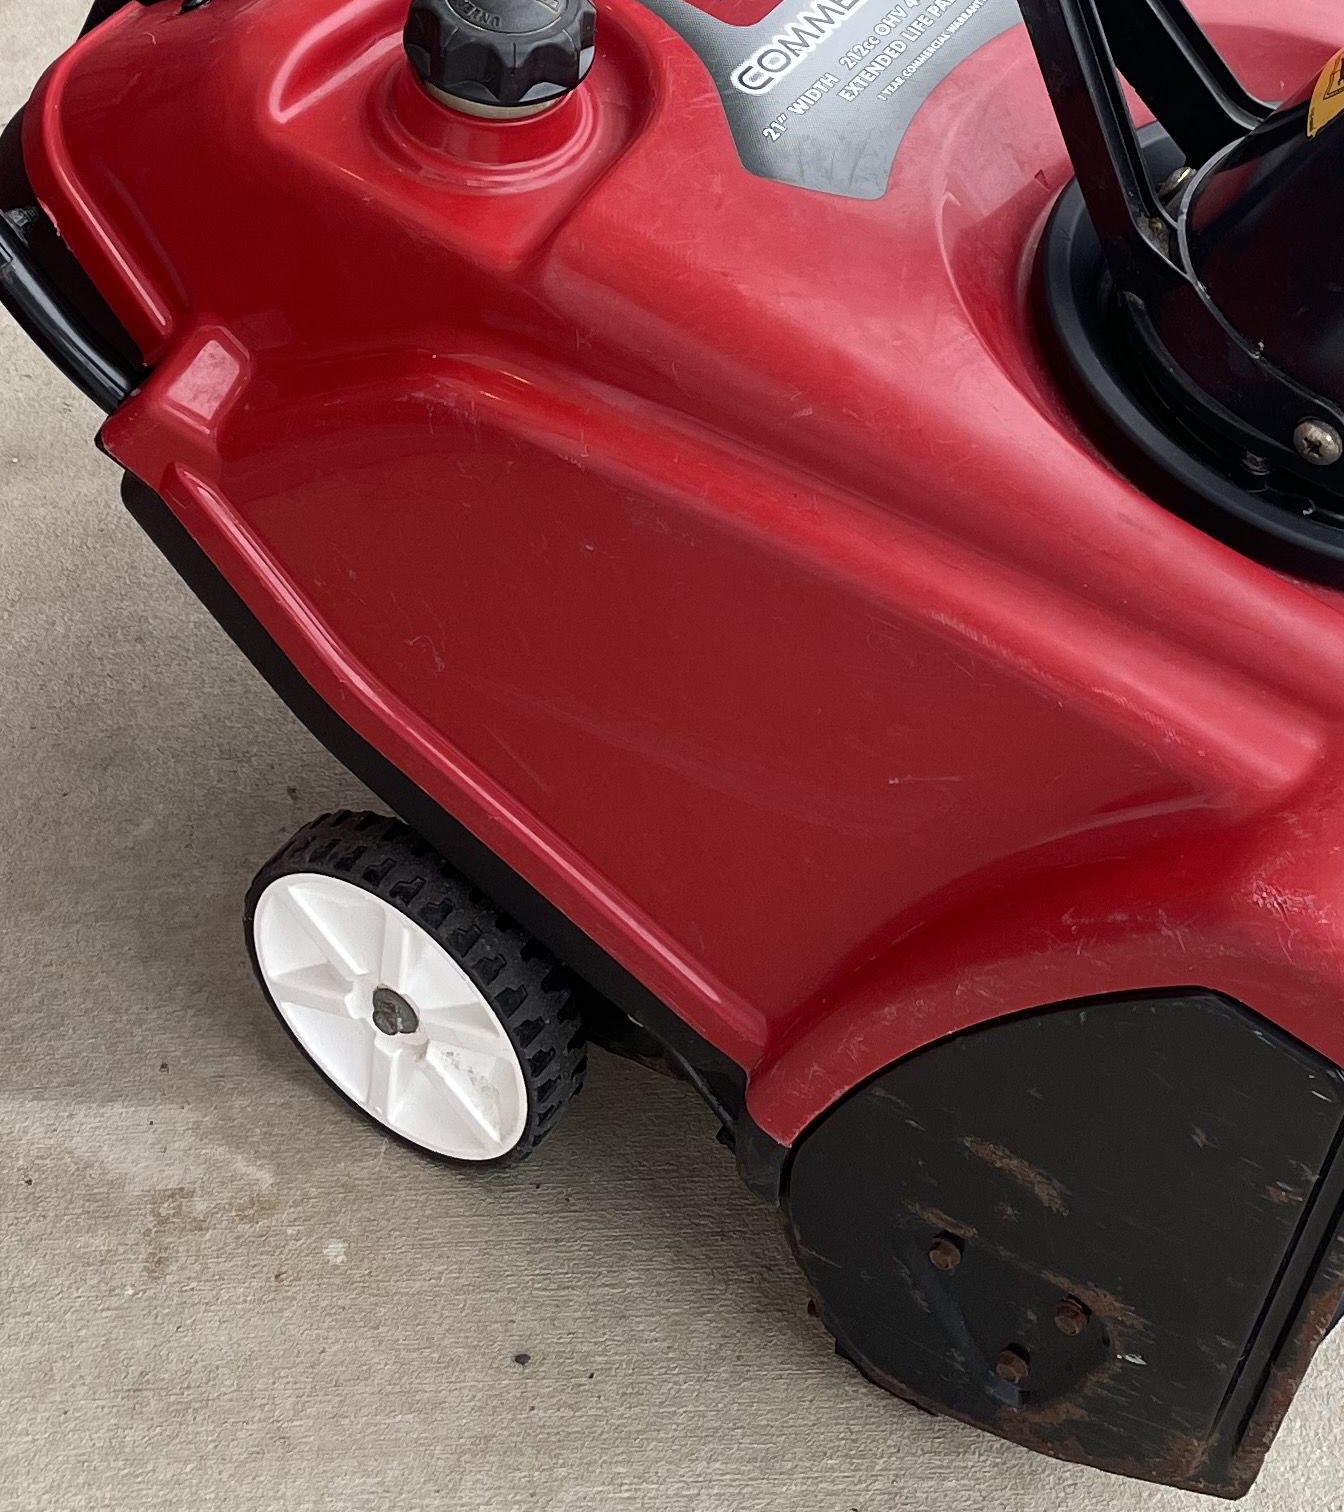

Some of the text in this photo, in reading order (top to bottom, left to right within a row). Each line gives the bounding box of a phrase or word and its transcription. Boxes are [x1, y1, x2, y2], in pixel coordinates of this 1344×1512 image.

[762, 113, 788, 143] 21"
[787, 71, 841, 116] WIDTH
[839, 34, 882, 71] 212cc
[874, 4, 908, 37] OHV
[836, 38, 908, 102] EXTENDED
[900, 13, 935, 43] LIFE
[876, 94, 888, 102] 1
[882, 75, 906, 97] YEAR
[901, 31, 951, 78] COMMERCIAL
